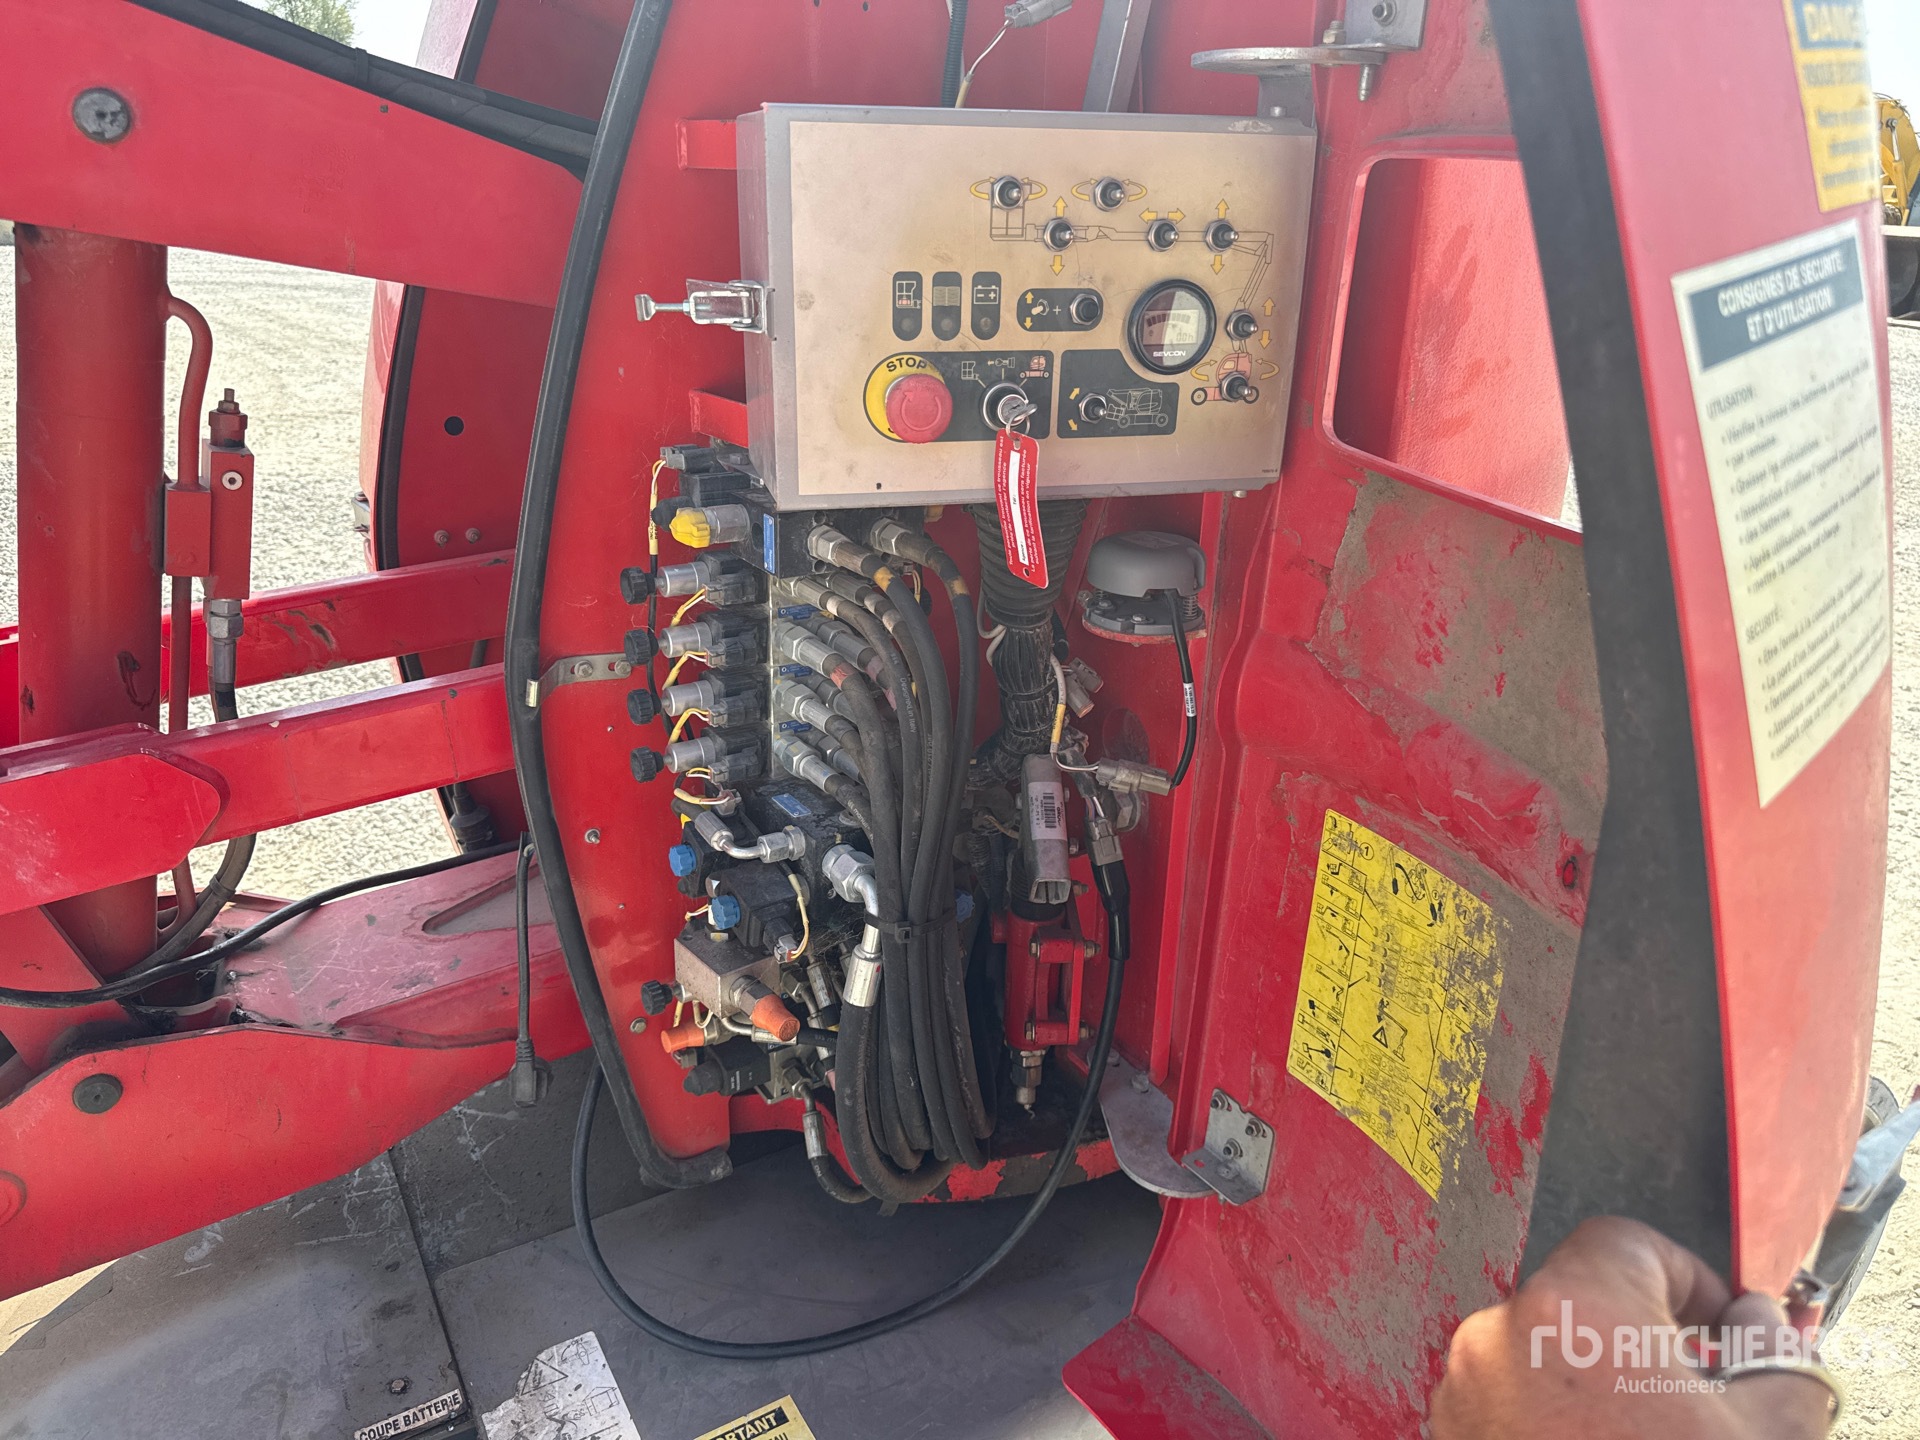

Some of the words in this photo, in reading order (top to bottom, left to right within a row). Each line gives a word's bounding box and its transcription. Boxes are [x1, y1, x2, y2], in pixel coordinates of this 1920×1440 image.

[1716, 272, 1783, 317] CONSIGNES
[1783, 266, 1799, 290] DE
[1746, 316, 1763, 341] ET
[1762, 289, 1832, 334] D'UTILISATION
[886, 356, 928, 372] STOP
[360, 1418, 401, 1440] COUPE
[403, 1393, 461, 1427] BATTERIE
